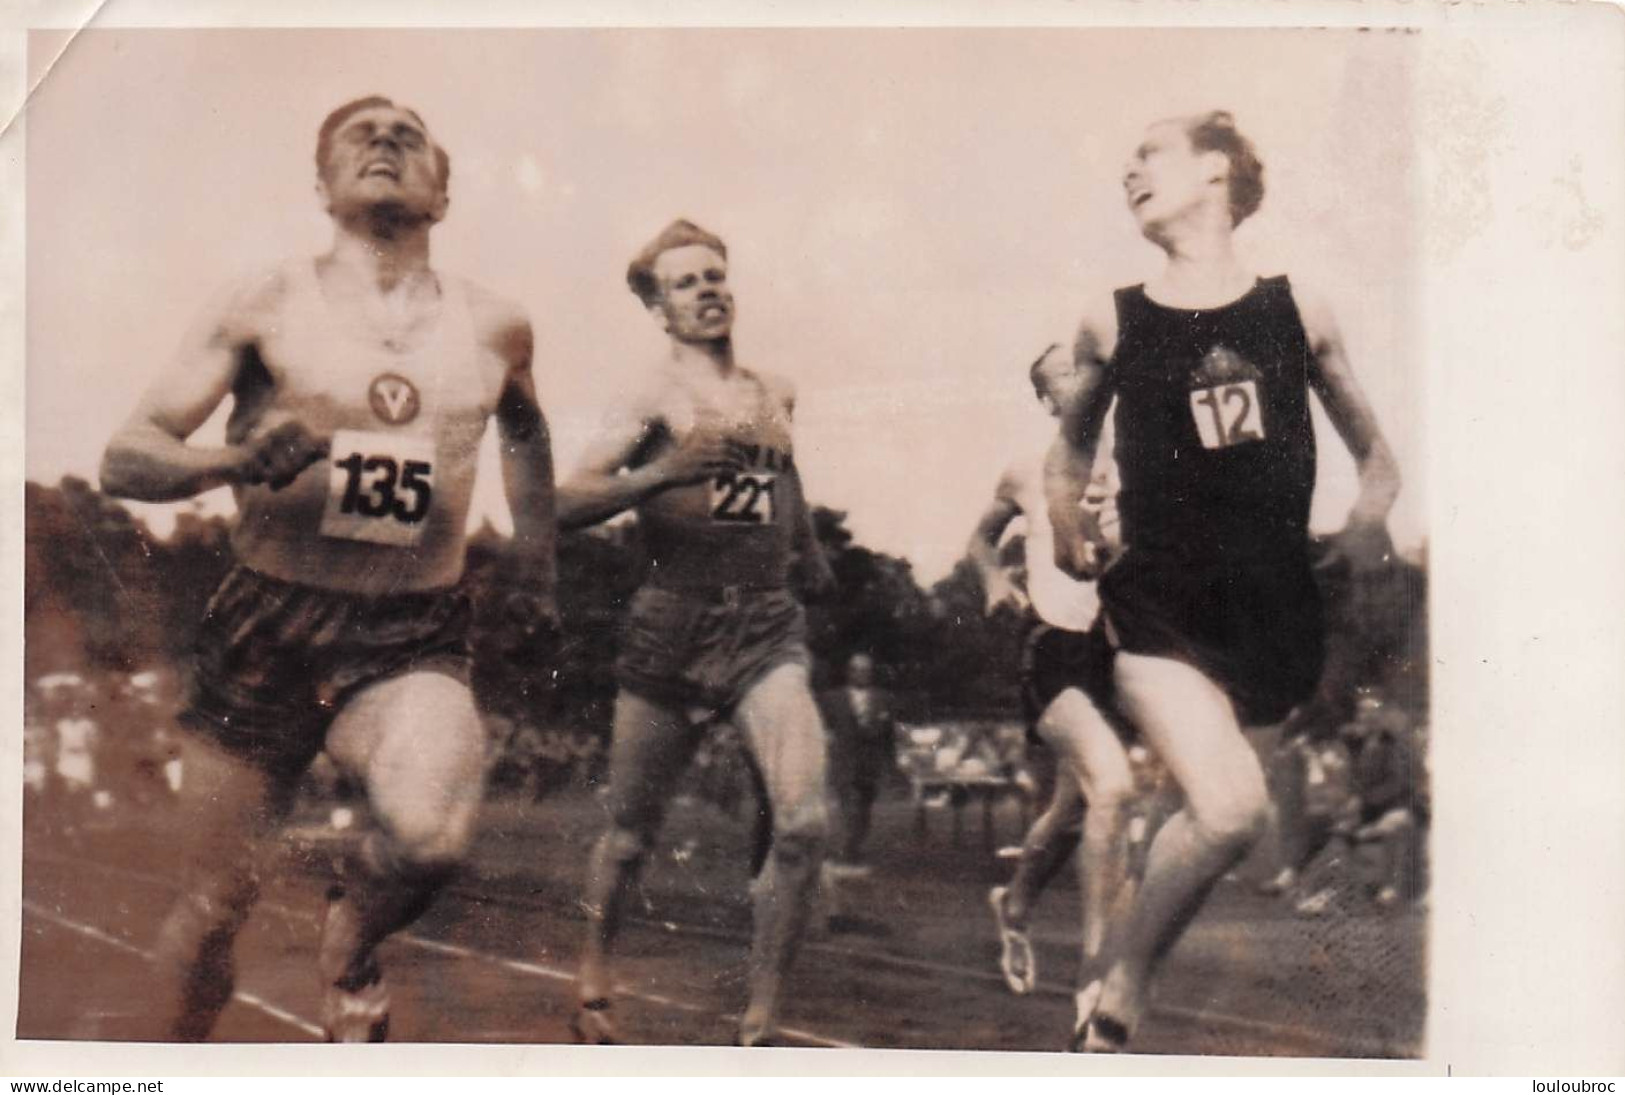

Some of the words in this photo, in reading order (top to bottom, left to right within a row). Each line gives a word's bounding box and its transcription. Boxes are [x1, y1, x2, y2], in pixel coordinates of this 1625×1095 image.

[374, 378, 411, 421] V
[1195, 387, 1260, 446] 12
[334, 453, 432, 523] 135
[711, 470, 775, 521] 221
